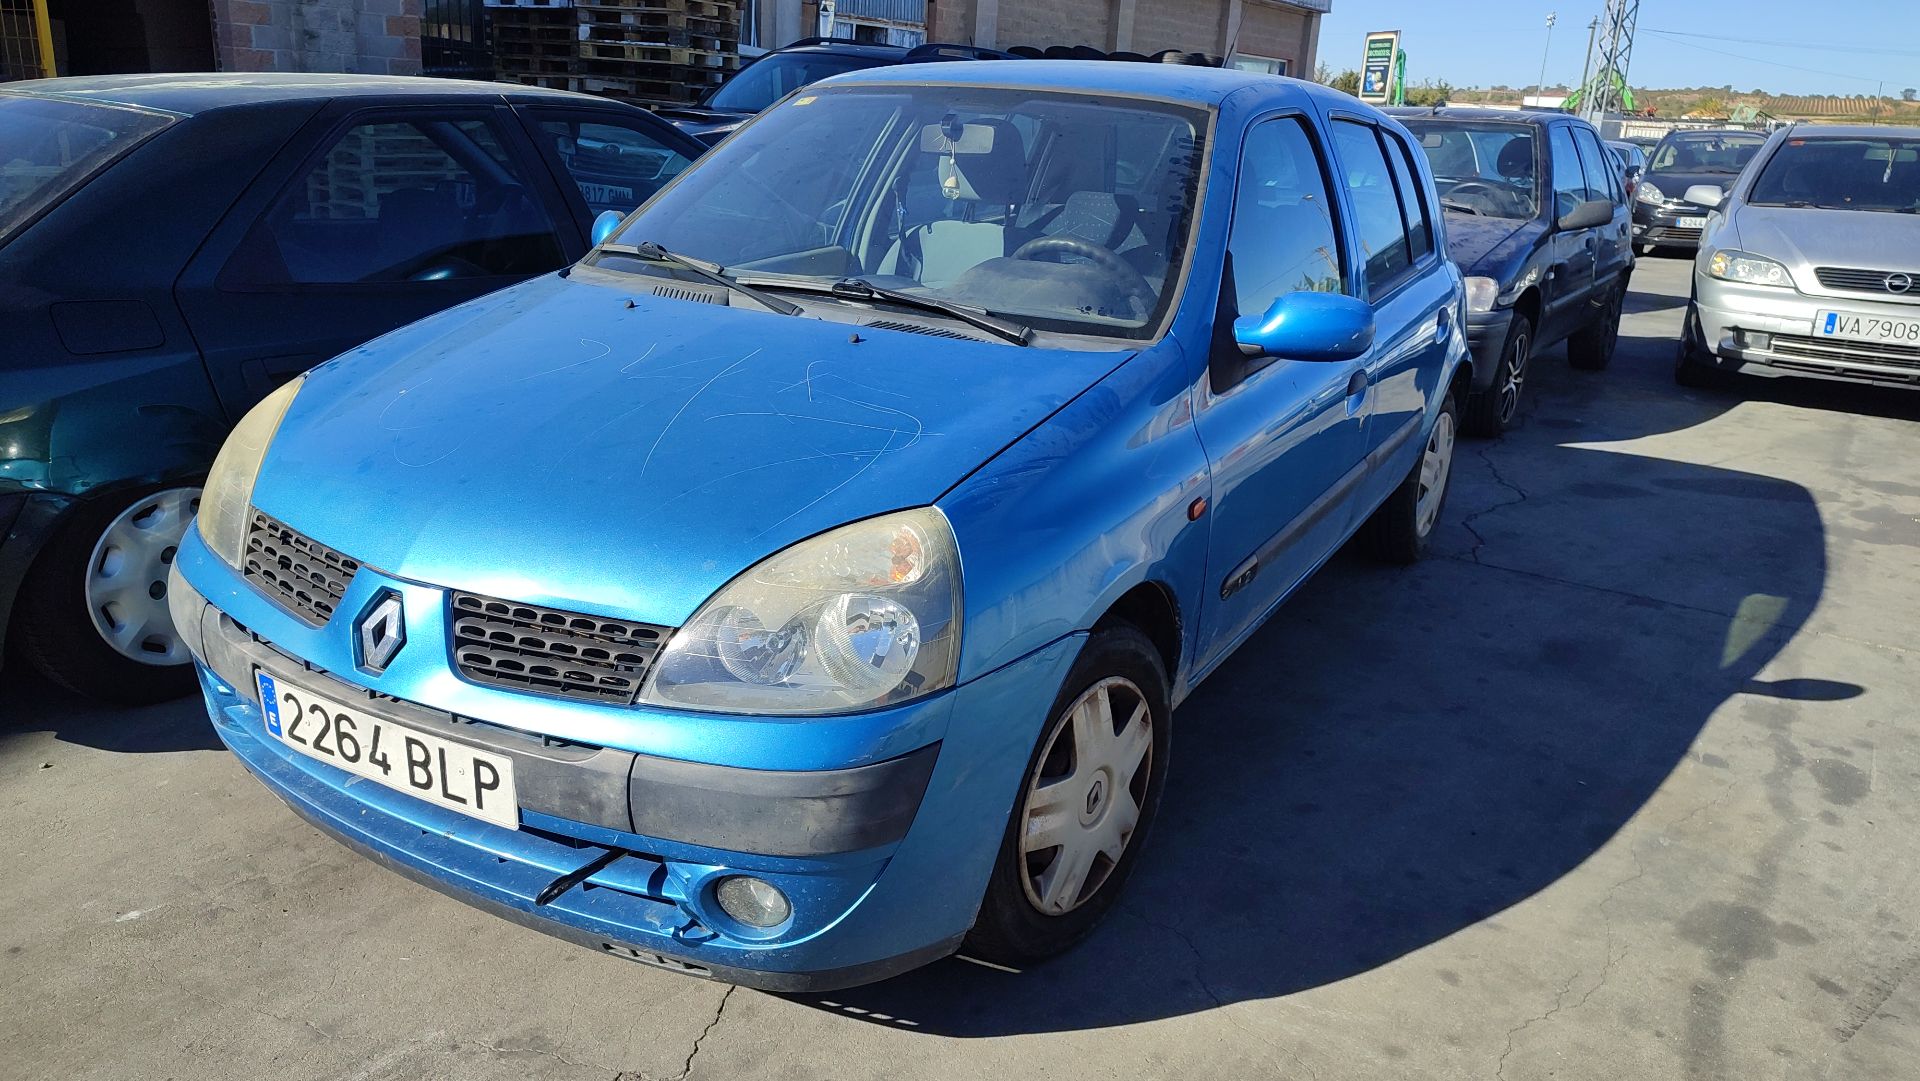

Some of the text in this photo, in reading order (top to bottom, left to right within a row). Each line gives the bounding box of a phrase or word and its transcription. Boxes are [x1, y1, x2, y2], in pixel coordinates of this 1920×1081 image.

[1839, 316, 1919, 340] VA 7908
[283, 692, 500, 810] 2264 BLP
